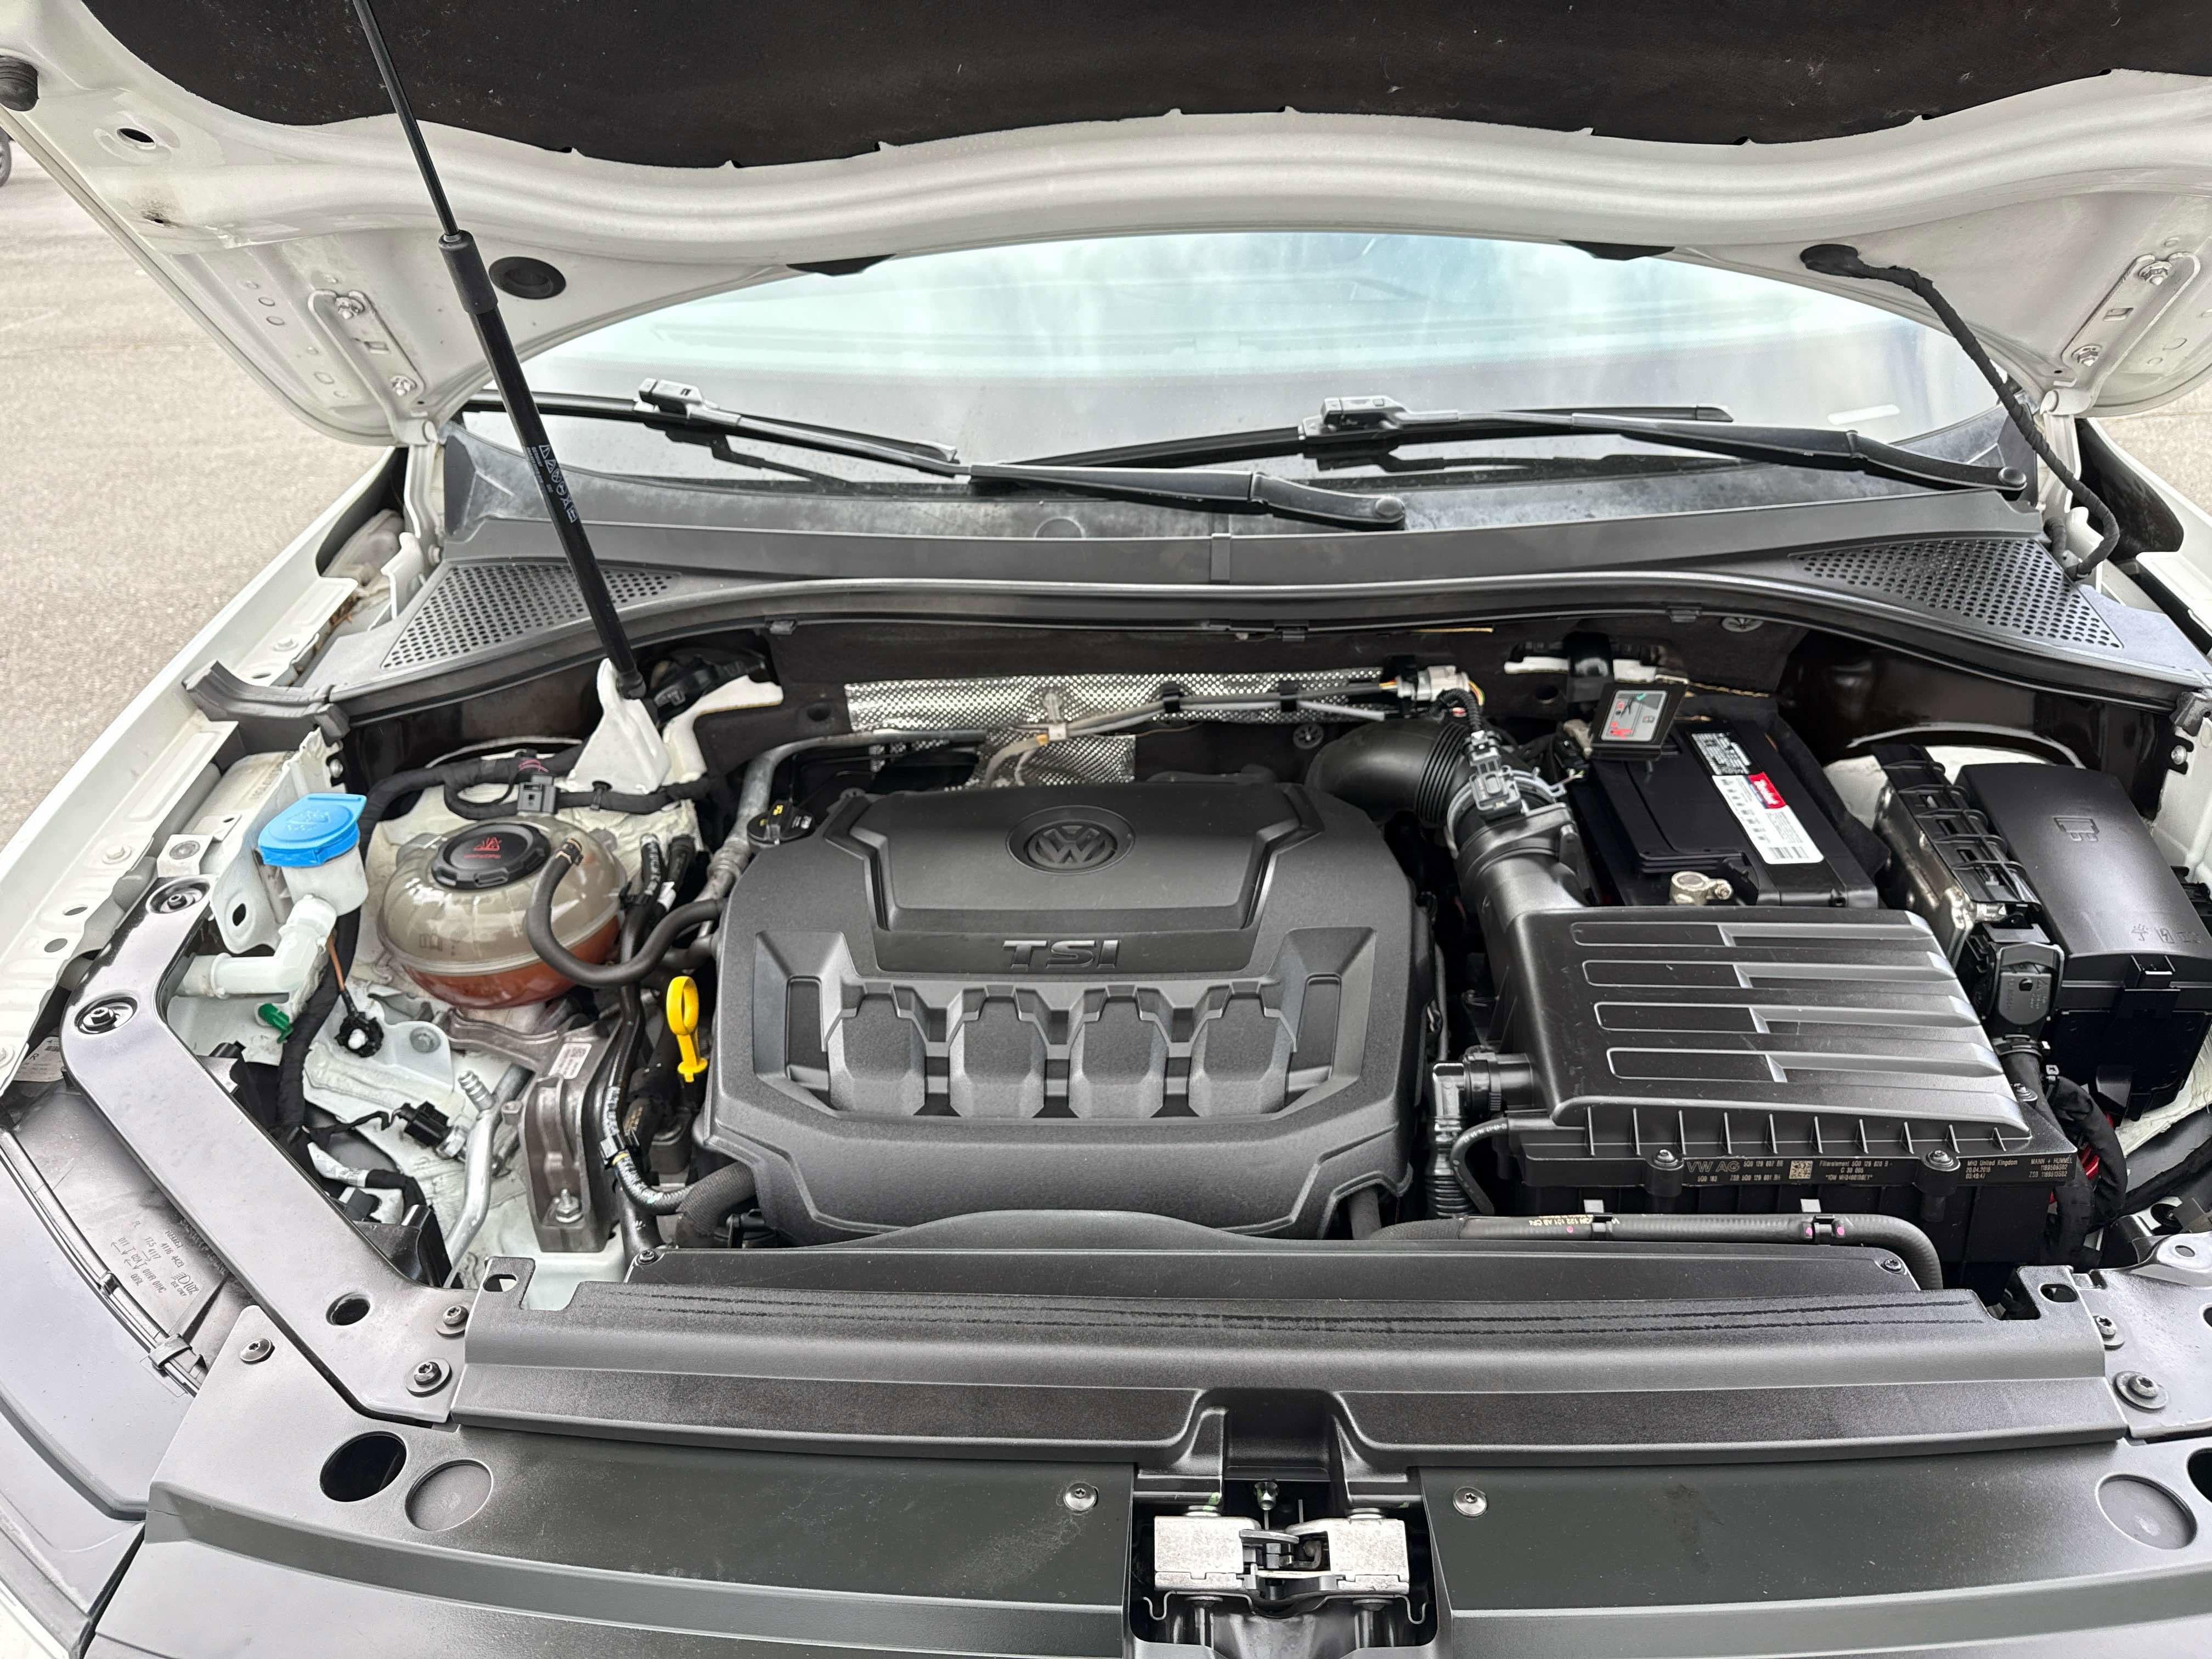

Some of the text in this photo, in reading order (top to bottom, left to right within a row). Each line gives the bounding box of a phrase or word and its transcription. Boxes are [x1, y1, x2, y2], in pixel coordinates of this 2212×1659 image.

[1003, 939, 1121, 970] TSI
[1686, 1160, 1740, 1172] VW AG
[148, 1249, 161, 1259] 4117
[161, 1242, 174, 1255] 4116
